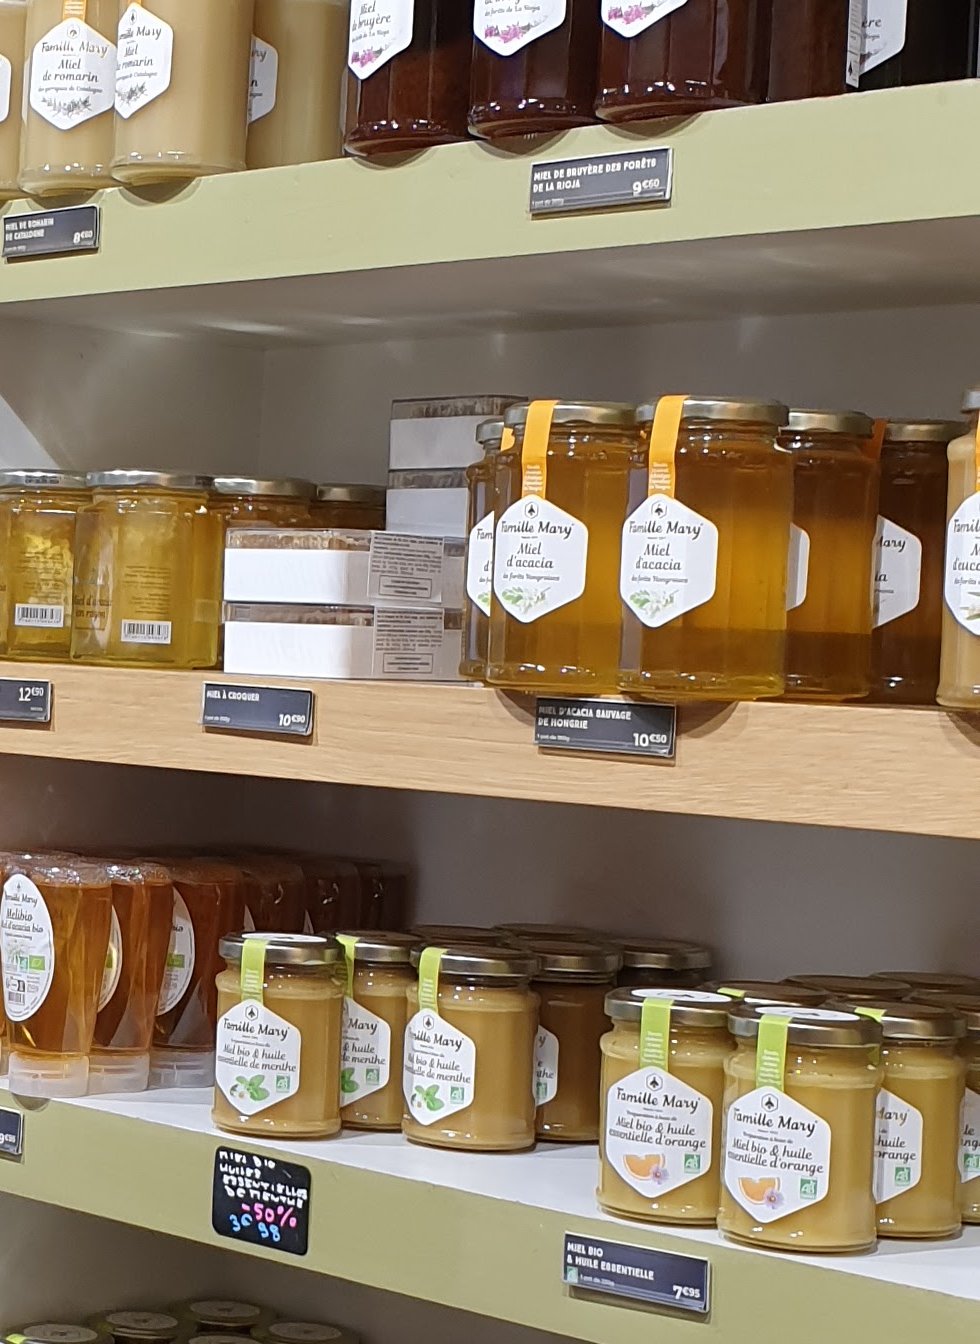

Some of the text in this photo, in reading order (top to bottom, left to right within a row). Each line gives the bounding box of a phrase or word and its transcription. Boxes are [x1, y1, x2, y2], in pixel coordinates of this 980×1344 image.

[57, 59, 82, 70] Miel
[53, 71, 99, 83] romarin
[533, 157, 657, 181] MIEL DE BRUYÈRE DES FORÊTS
[532, 179, 580, 192] DE LA RIOJA
[502, 521, 573, 540] Famille Mary
[629, 521, 662, 537] Famille
[517, 543, 542, 556] Miel
[643, 543, 670, 557] Miel
[506, 556, 554, 570] d'acacia
[635, 558, 681, 572] d'acacia
[538, 716, 588, 730] DE HONGRIE
[258, 1024, 290, 1041] Mary
[261, 1049, 286, 1061] huile
[351, 1042, 375, 1054] huile
[261, 1060, 296, 1072] menthe
[353, 1053, 386, 1065] menthe
[436, 1059, 460, 1071] huile
[437, 1071, 470, 1084] menthe
[617, 1087, 658, 1107] Famille
[733, 1107, 774, 1128] Famille
[666, 1124, 695, 1137] huile
[655, 1133, 706, 1151] d'orange
[782, 1147, 812, 1161] huile
[770, 1156, 823, 1175] d'orange
[567, 1242, 604, 1257] MIEL BIO
[575, 1256, 598, 1269] HUILE
[601, 1261, 654, 1280] ESSENTIELLE
